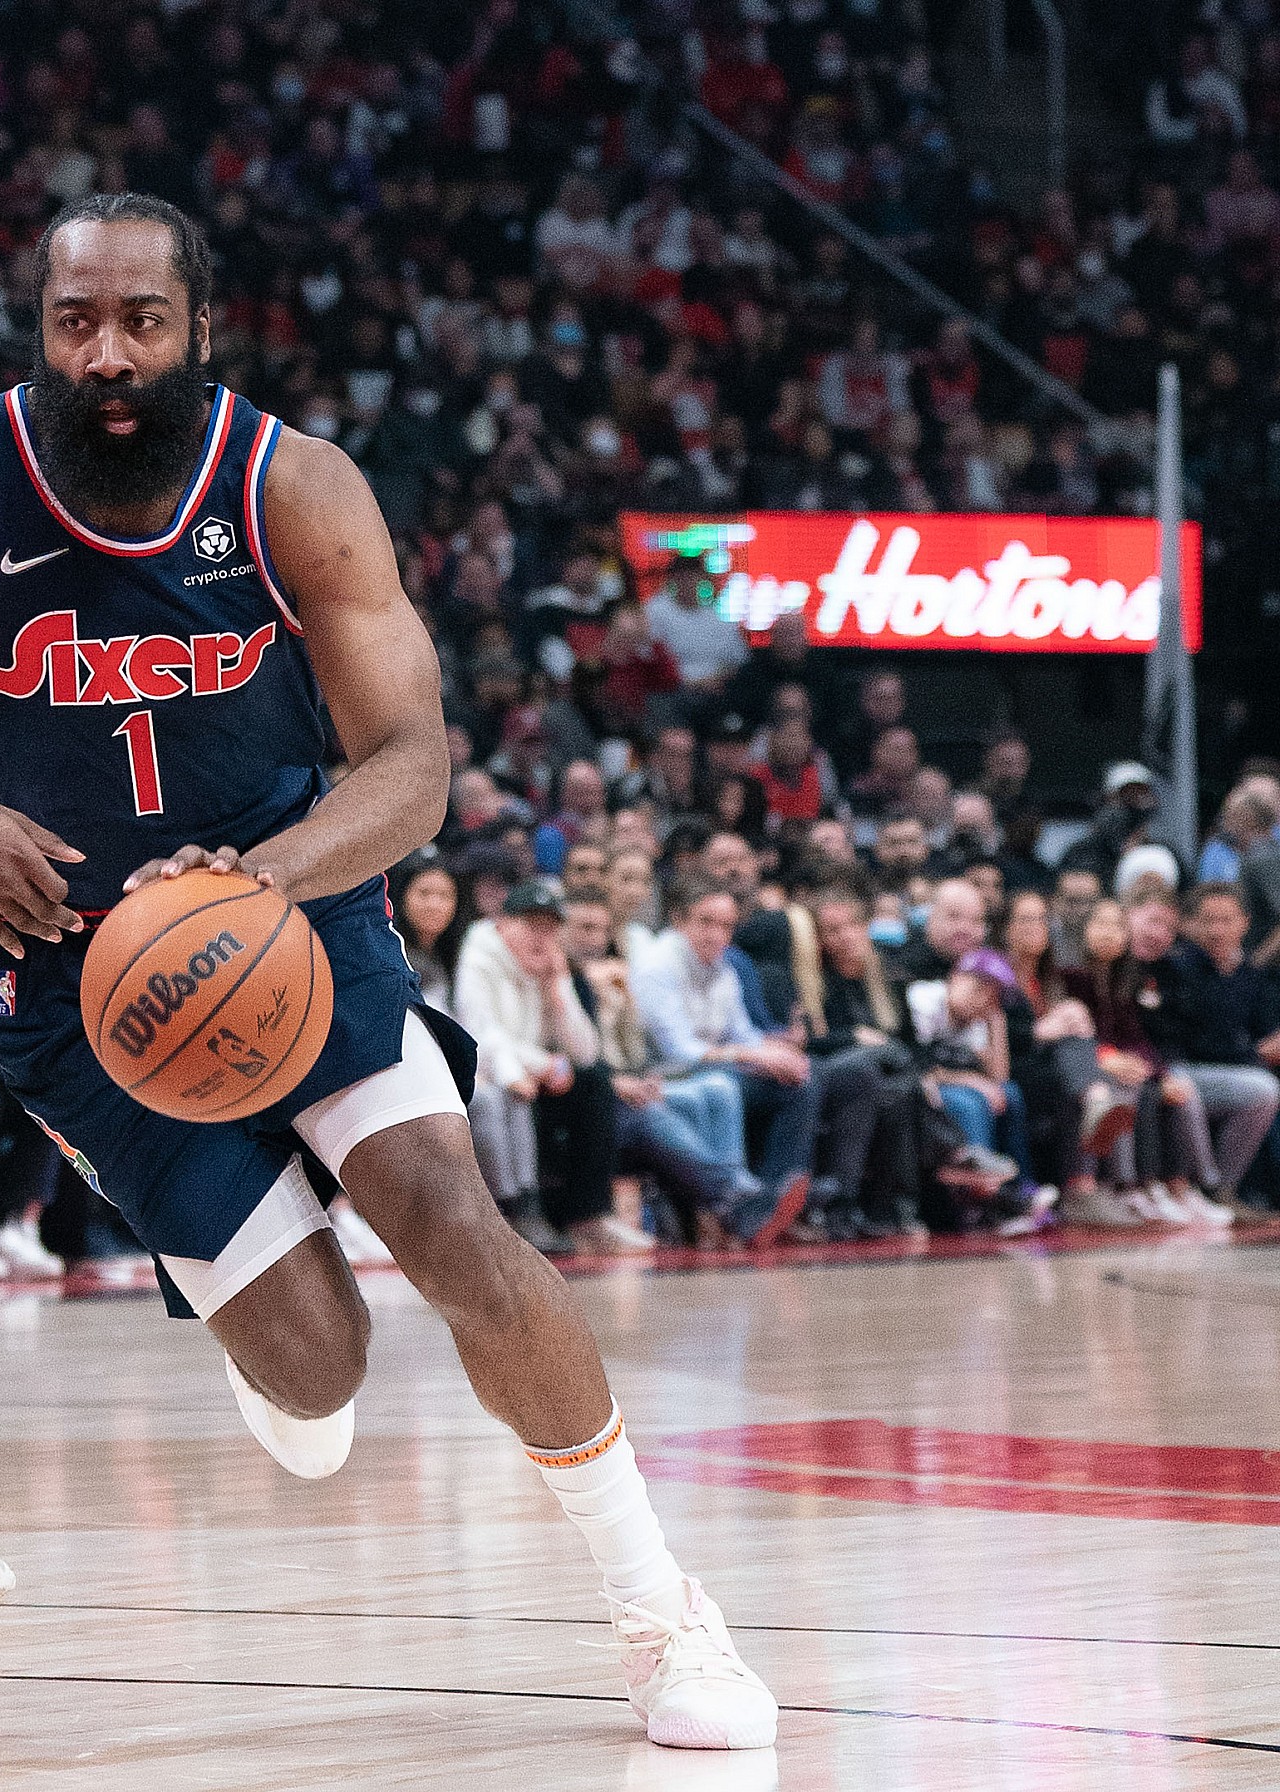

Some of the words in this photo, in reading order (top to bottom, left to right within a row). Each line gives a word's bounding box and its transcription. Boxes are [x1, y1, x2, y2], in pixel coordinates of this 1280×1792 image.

[183, 563, 257, 587] crypto.com
[817, 517, 1162, 641] Hortons
[111, 710, 164, 817] 1
[108, 929, 247, 1060] Wilson
